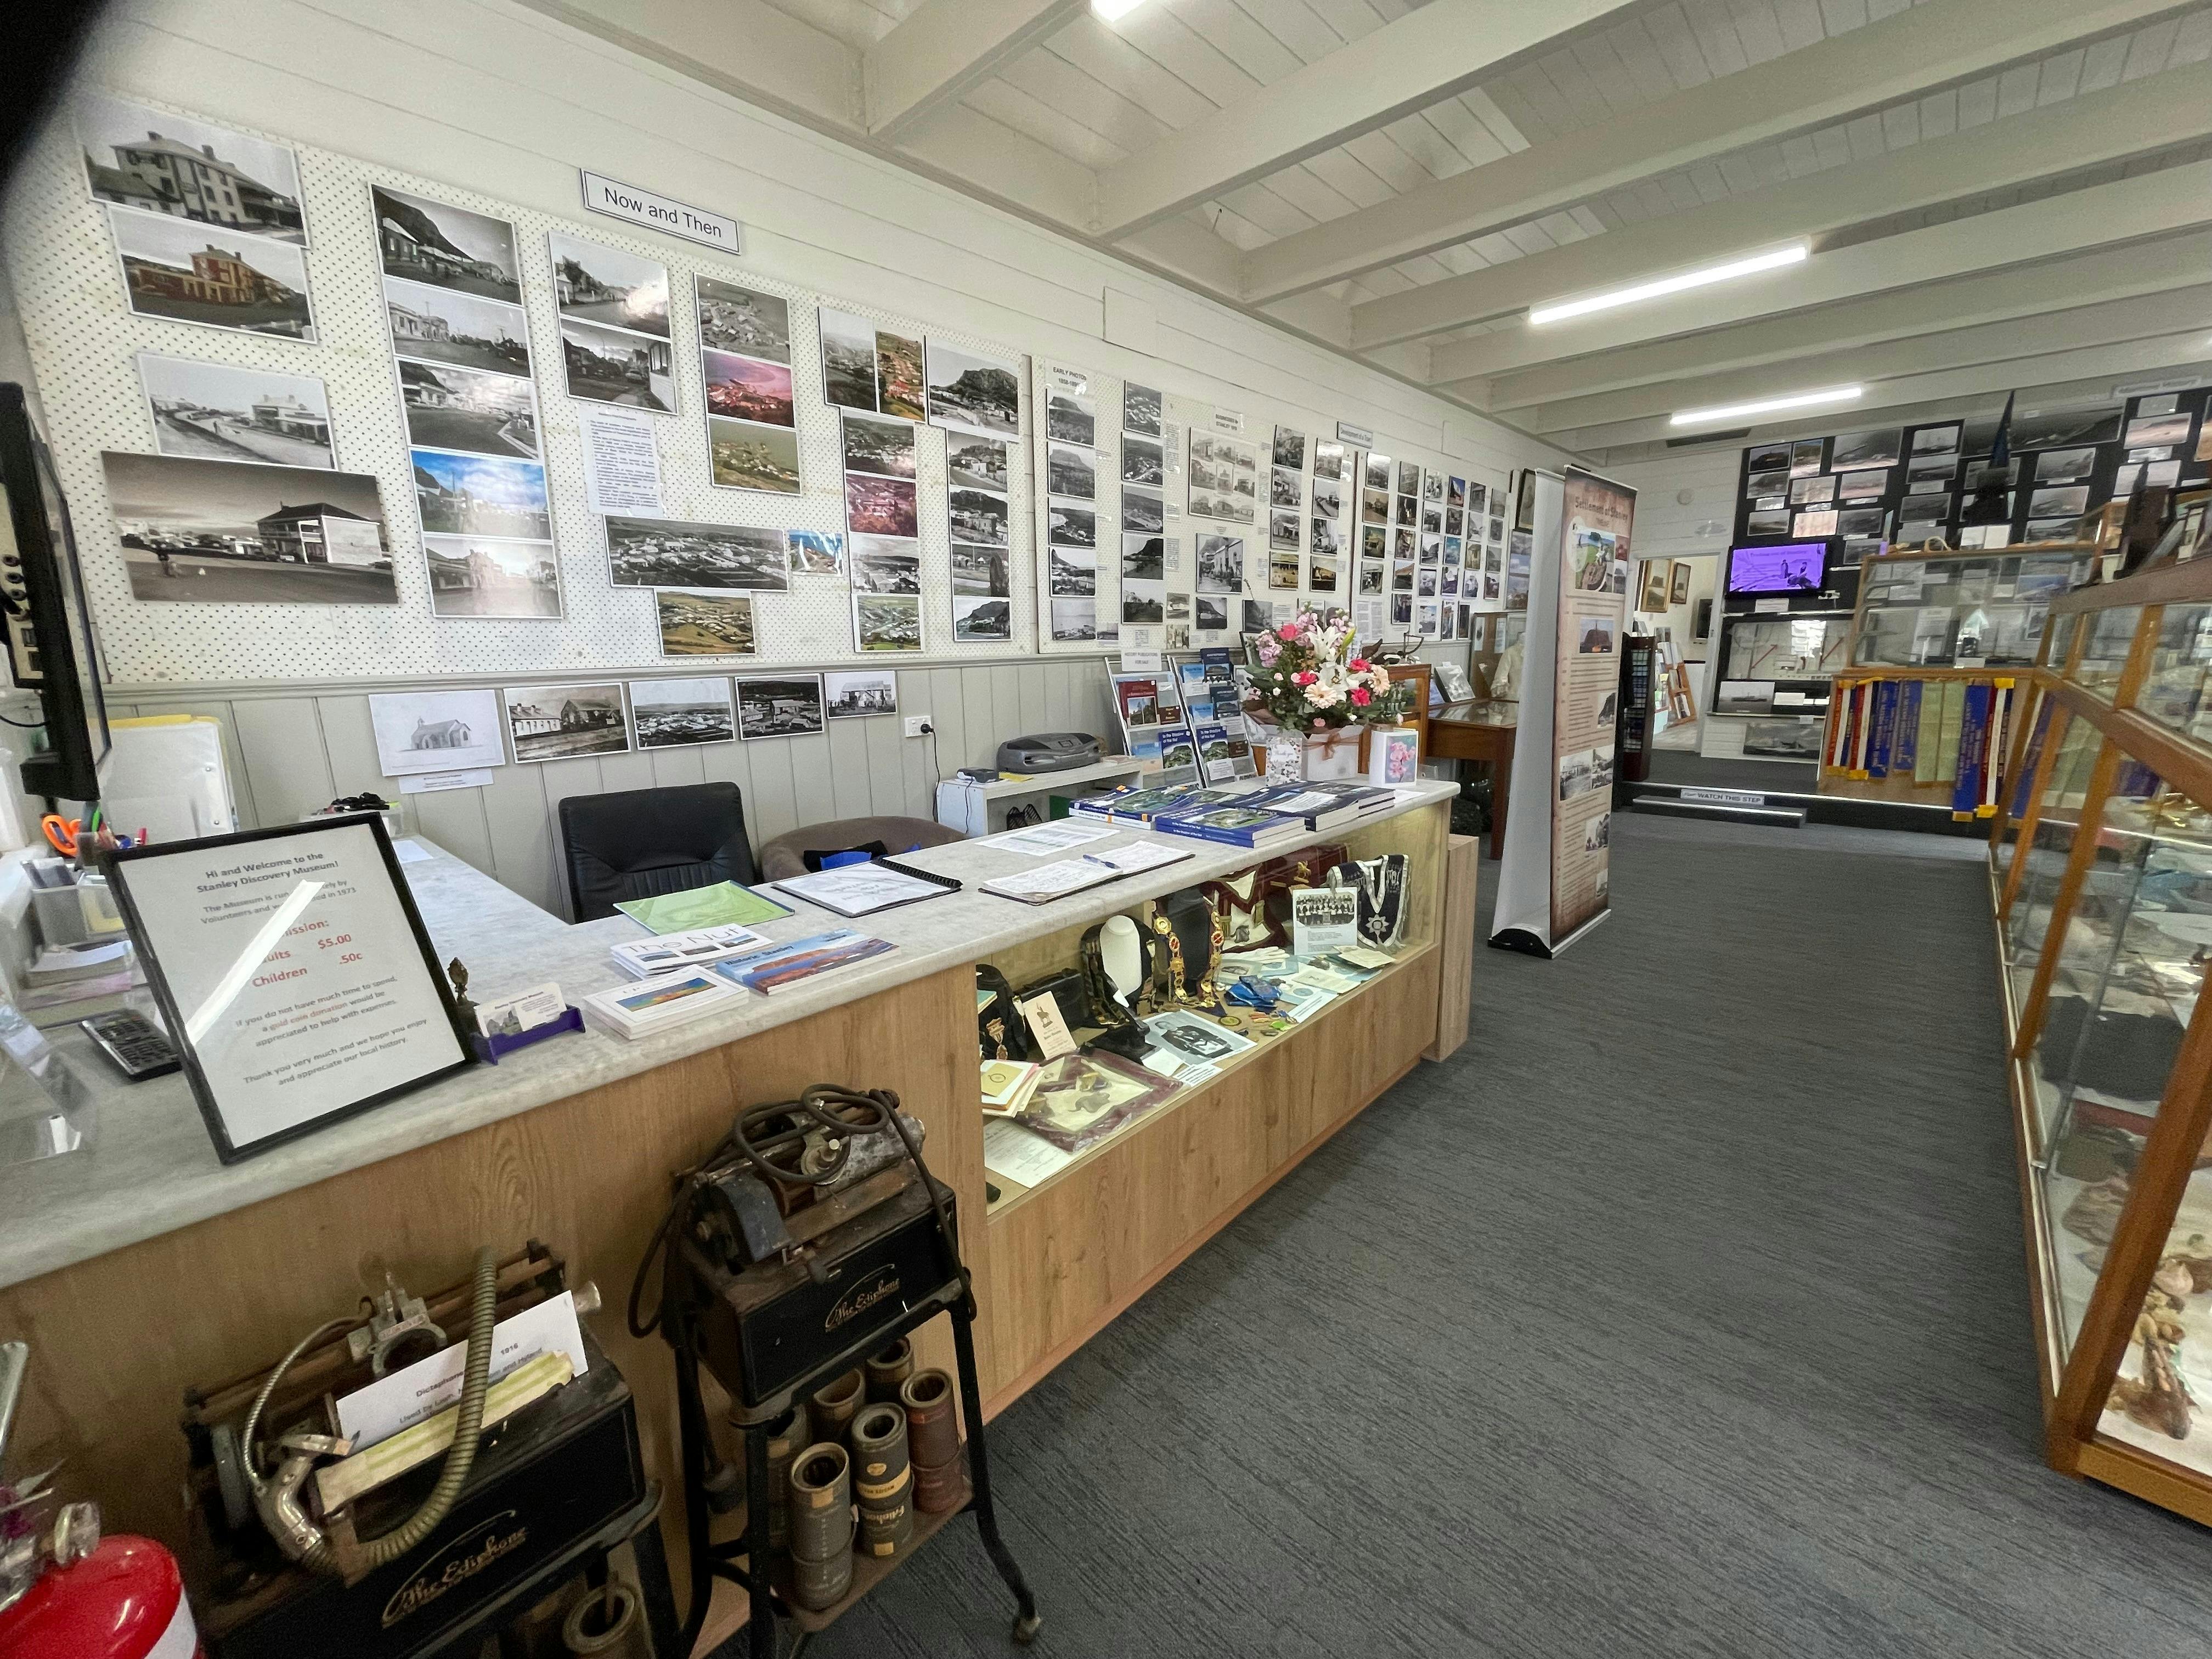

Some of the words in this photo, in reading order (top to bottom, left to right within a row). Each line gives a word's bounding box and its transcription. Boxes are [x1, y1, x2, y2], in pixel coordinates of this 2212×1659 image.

[605, 187, 642, 212] Now
[649, 205, 678, 224] and
[682, 212, 721, 238] Then
[1053, 367, 1069, 375] EARLY
[197, 879, 238, 893] Stanley
[240, 870, 290, 885] Discovery
[294, 860, 339, 875] Museum!
[206, 870, 218, 879] Hi
[222, 867, 241, 877] and
[243, 859, 292, 872] Welcome
[307, 852, 324, 861] the
[201, 910, 252, 924] Volunteers
[255, 905, 270, 913] and
[337, 887, 357, 896] 1973
[203, 905, 221, 913] The
[274, 891, 289, 900] run
[284, 920, 329, 936] ission:
[621, 941, 682, 952] The
[687, 927, 740, 943] Nut
[263, 950, 291, 963] ults
[318, 934, 352, 949] $5.00
[252, 967, 307, 987] Children
[339, 953, 363, 964] .50c
[245, 1015, 262, 1026] you
[278, 1006, 294, 1015] not
[294, 1000, 316, 1009] have
[318, 992, 341, 1003] much
[342, 987, 360, 997] time
[270, 1019, 289, 1031] gold
[290, 1014, 308, 1024] coin
[310, 1002, 348, 1017] donation
[349, 995, 374, 1006] would
[256, 1025, 308, 1047] appreciated
[320, 1016, 340, 1028] help
[341, 1009, 359, 1020] with
[243, 1070, 273, 1084] Thank
[274, 1065, 291, 1075] you
[292, 1057, 312, 1069] very
[313, 1048, 337, 1060] much
[339, 1042, 355, 1052] and
[356, 1037, 368, 1046] we
[370, 1030, 390, 1043] hope
[391, 1026, 405, 1036] you
[407, 1018, 427, 1031] enjoy
[278, 1075, 295, 1086] and
[297, 1059, 343, 1079] appreciate
[343, 1053, 358, 1063] our
[359, 1046, 379, 1058] local
[416, 1370, 465, 1397] Dictaphone
[500, 1343, 518, 1355] 1916
